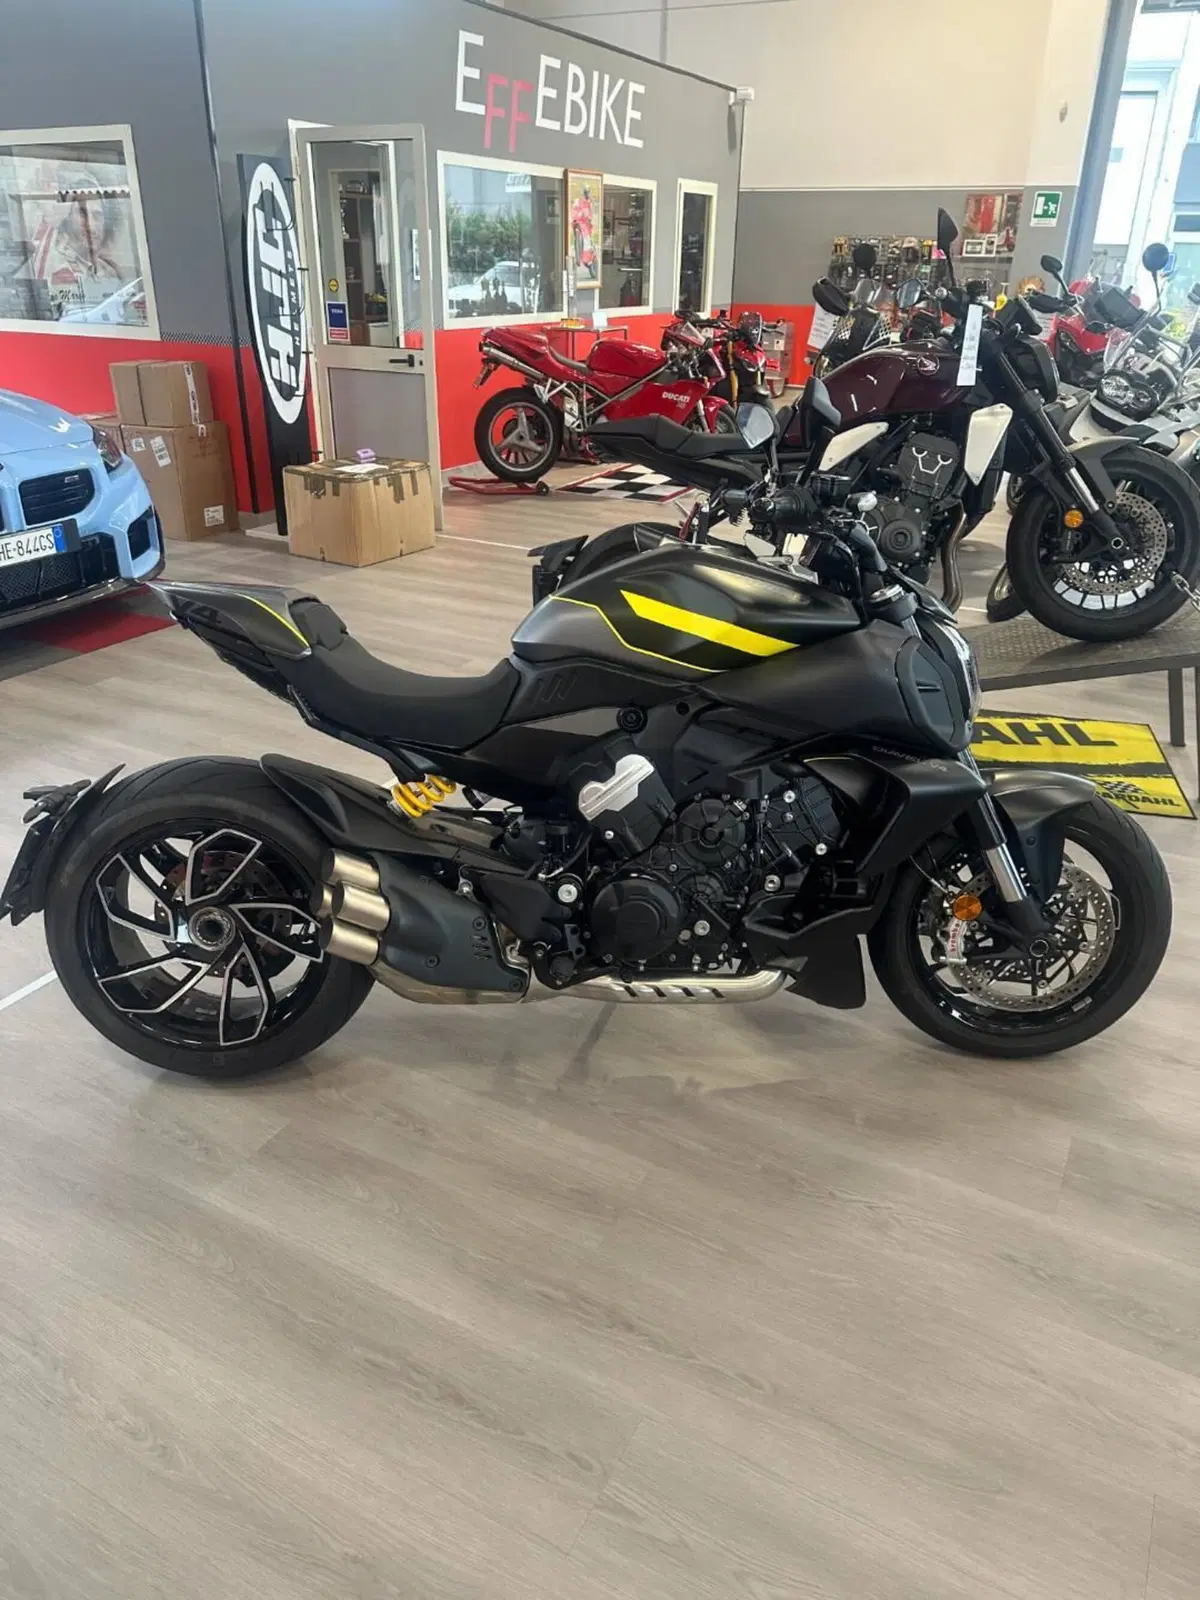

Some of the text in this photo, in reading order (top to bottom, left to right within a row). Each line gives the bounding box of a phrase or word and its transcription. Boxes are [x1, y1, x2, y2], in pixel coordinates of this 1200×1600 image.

[455, 29, 646, 153] EFFEBIKE
[253, 206, 298, 388] HJC
[661, 391, 691, 403] DUCATI
[1097, 790, 1181, 808] ARDAHL
